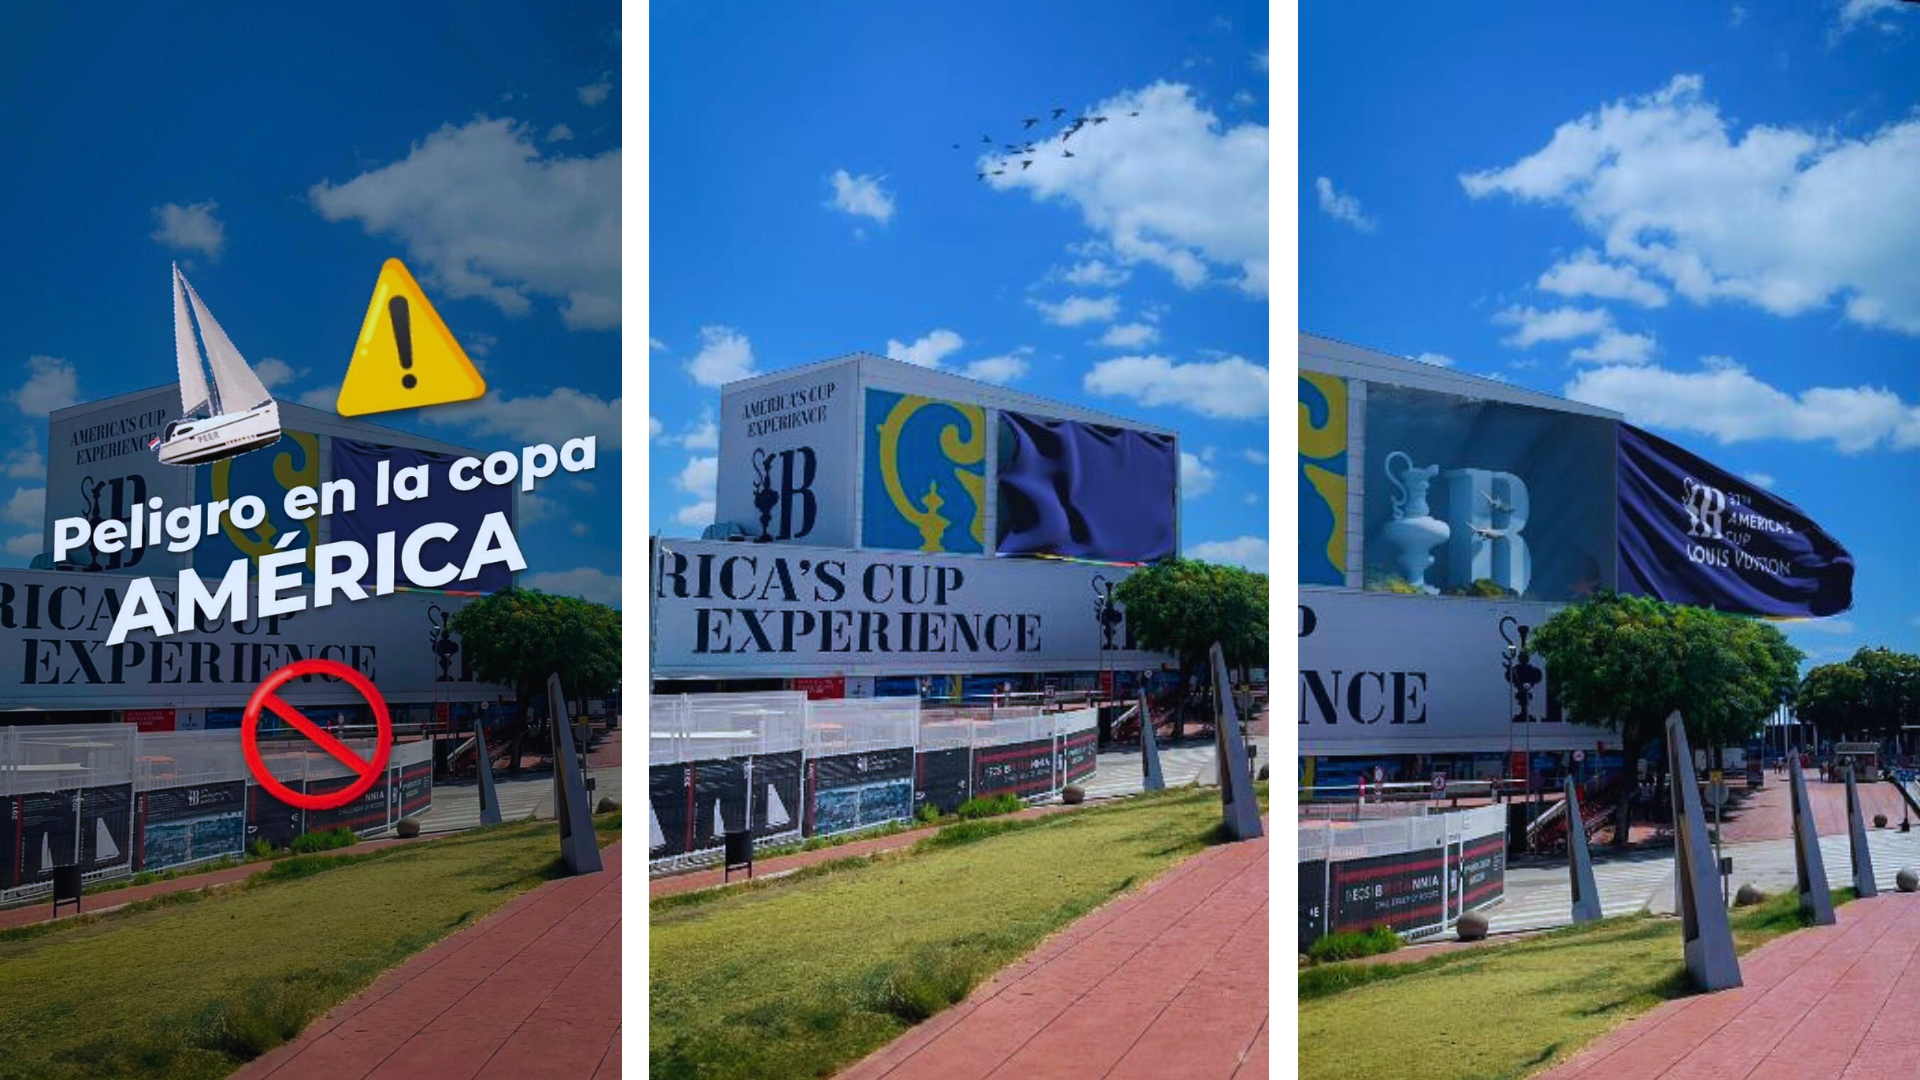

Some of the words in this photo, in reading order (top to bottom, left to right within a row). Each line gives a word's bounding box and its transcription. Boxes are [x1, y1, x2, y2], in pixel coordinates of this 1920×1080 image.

[743, 389, 806, 419] AMERICA'S
[808, 382, 836, 403] CUP
[70, 415, 137, 447] AMERICA'S
[139, 409, 166, 431] CUP
[748, 405, 827, 438] EXPERIENCE
[1687, 543, 1730, 567] LOUIS
[862, 563, 964, 606] CUP
[692, 607, 1042, 655] EXPERIENCE
[20, 638, 377, 685] EXPERIENCE
